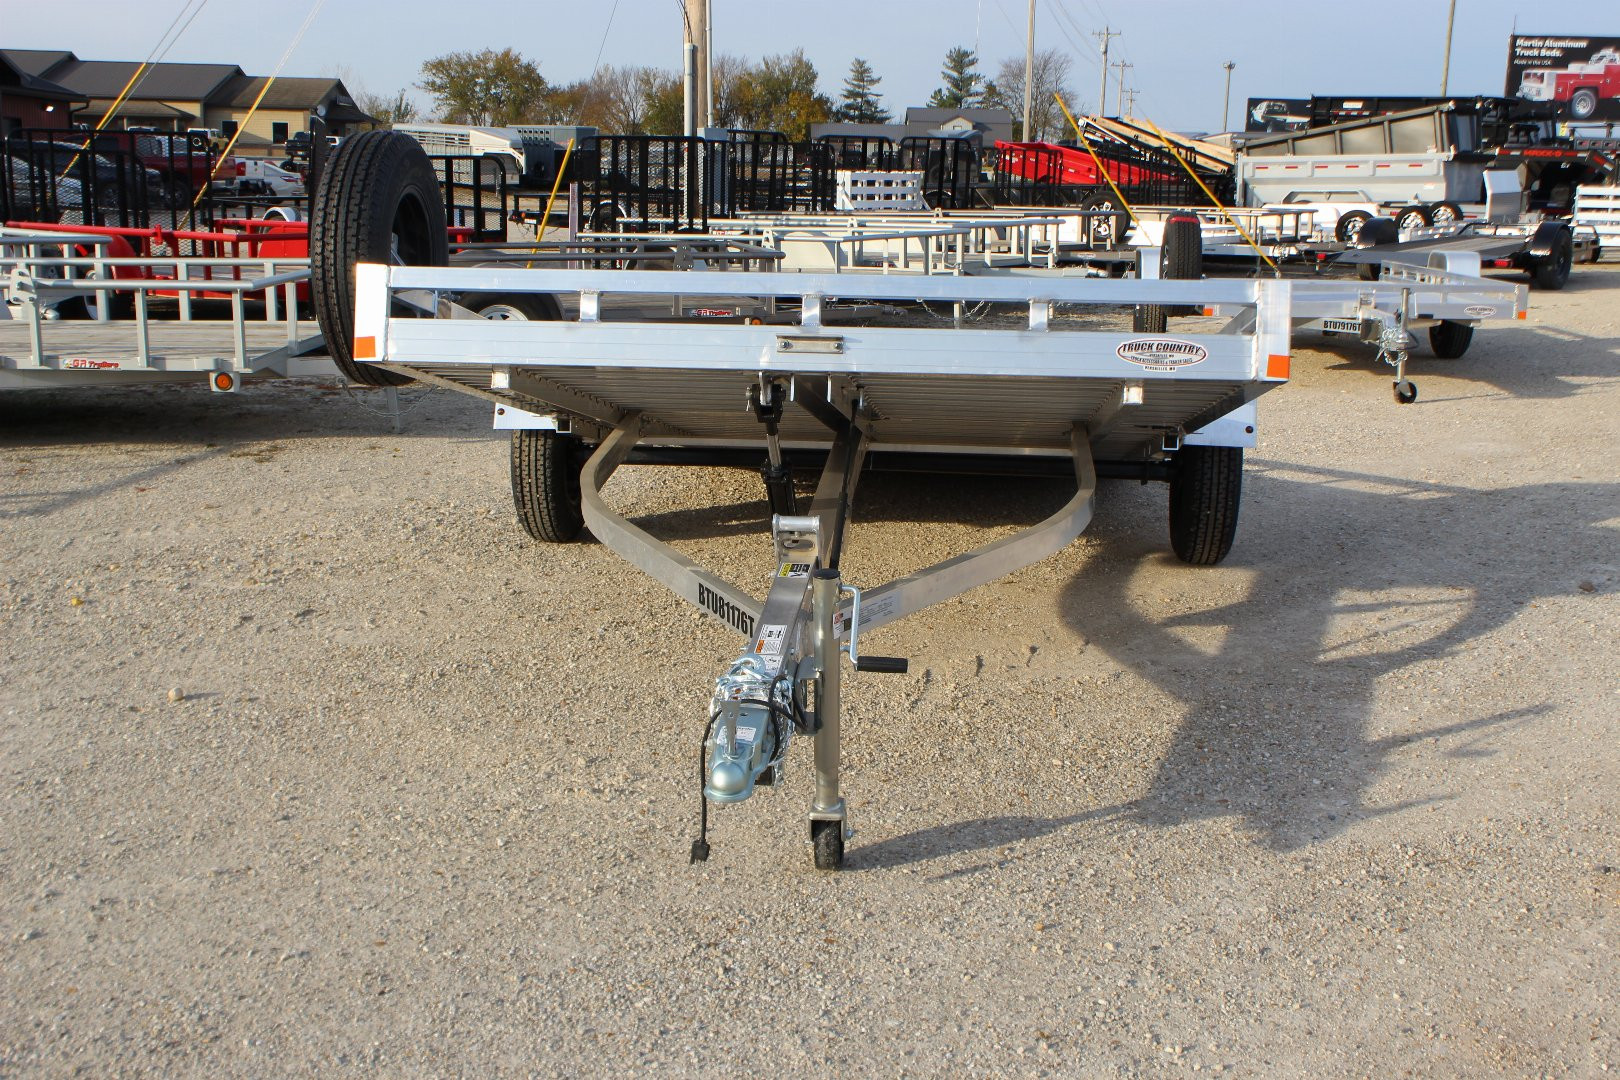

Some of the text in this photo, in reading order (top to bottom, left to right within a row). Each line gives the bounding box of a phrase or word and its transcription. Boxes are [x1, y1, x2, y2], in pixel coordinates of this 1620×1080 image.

[1515, 39, 1587, 48] Martin Aluminum
[1515, 48, 1539, 57] Truck
[1122, 342, 1201, 355] TRUCK COUNTRY
[698, 583, 755, 639] BTU81176T
